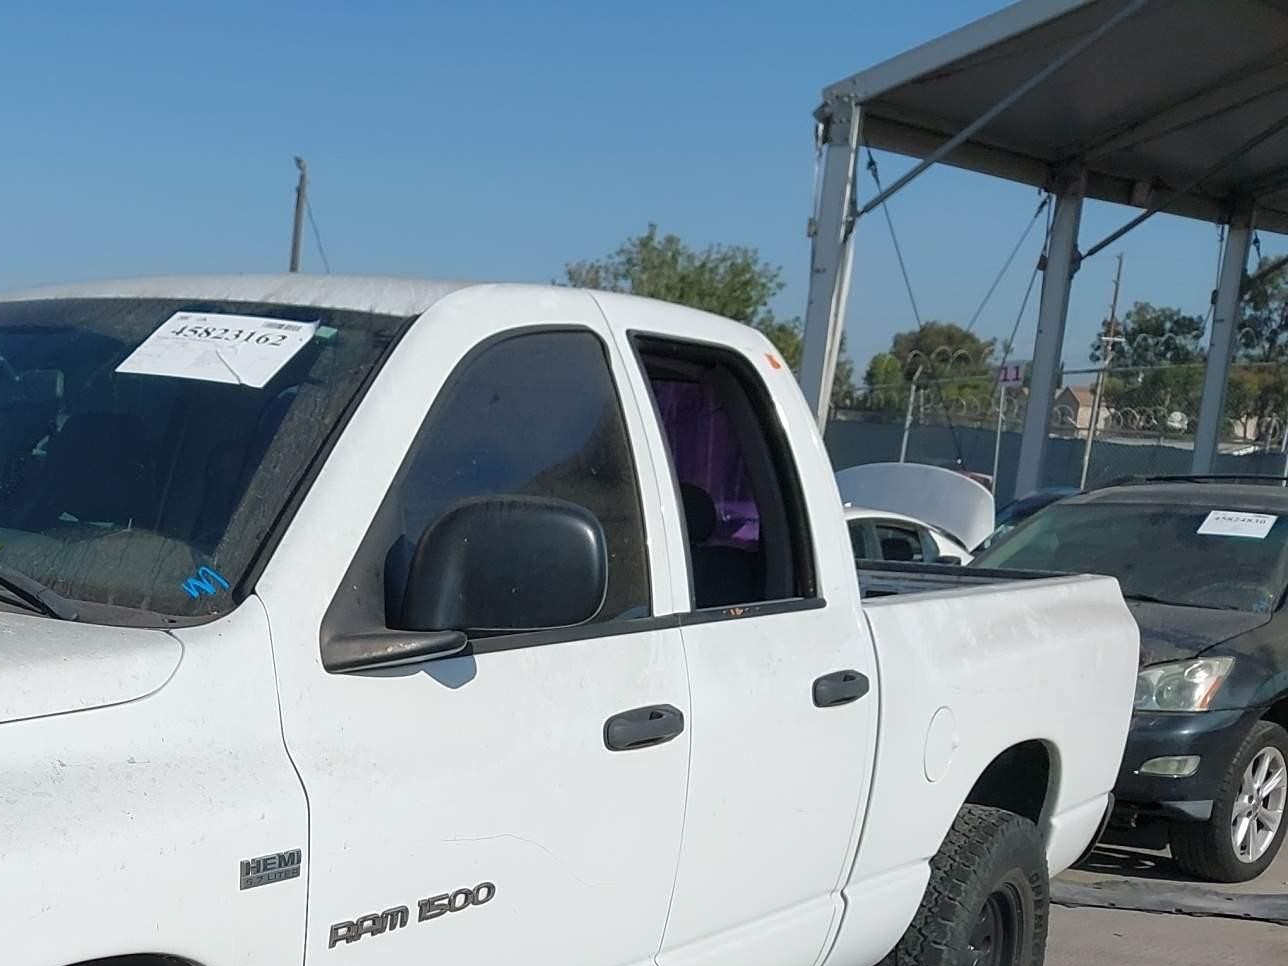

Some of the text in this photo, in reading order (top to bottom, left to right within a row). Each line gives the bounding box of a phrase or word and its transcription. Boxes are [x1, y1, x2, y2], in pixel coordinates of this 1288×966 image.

[170, 325, 288, 346] 45823162
[240, 848, 302, 877] HEMI
[328, 881, 496, 949] RAM 1500
